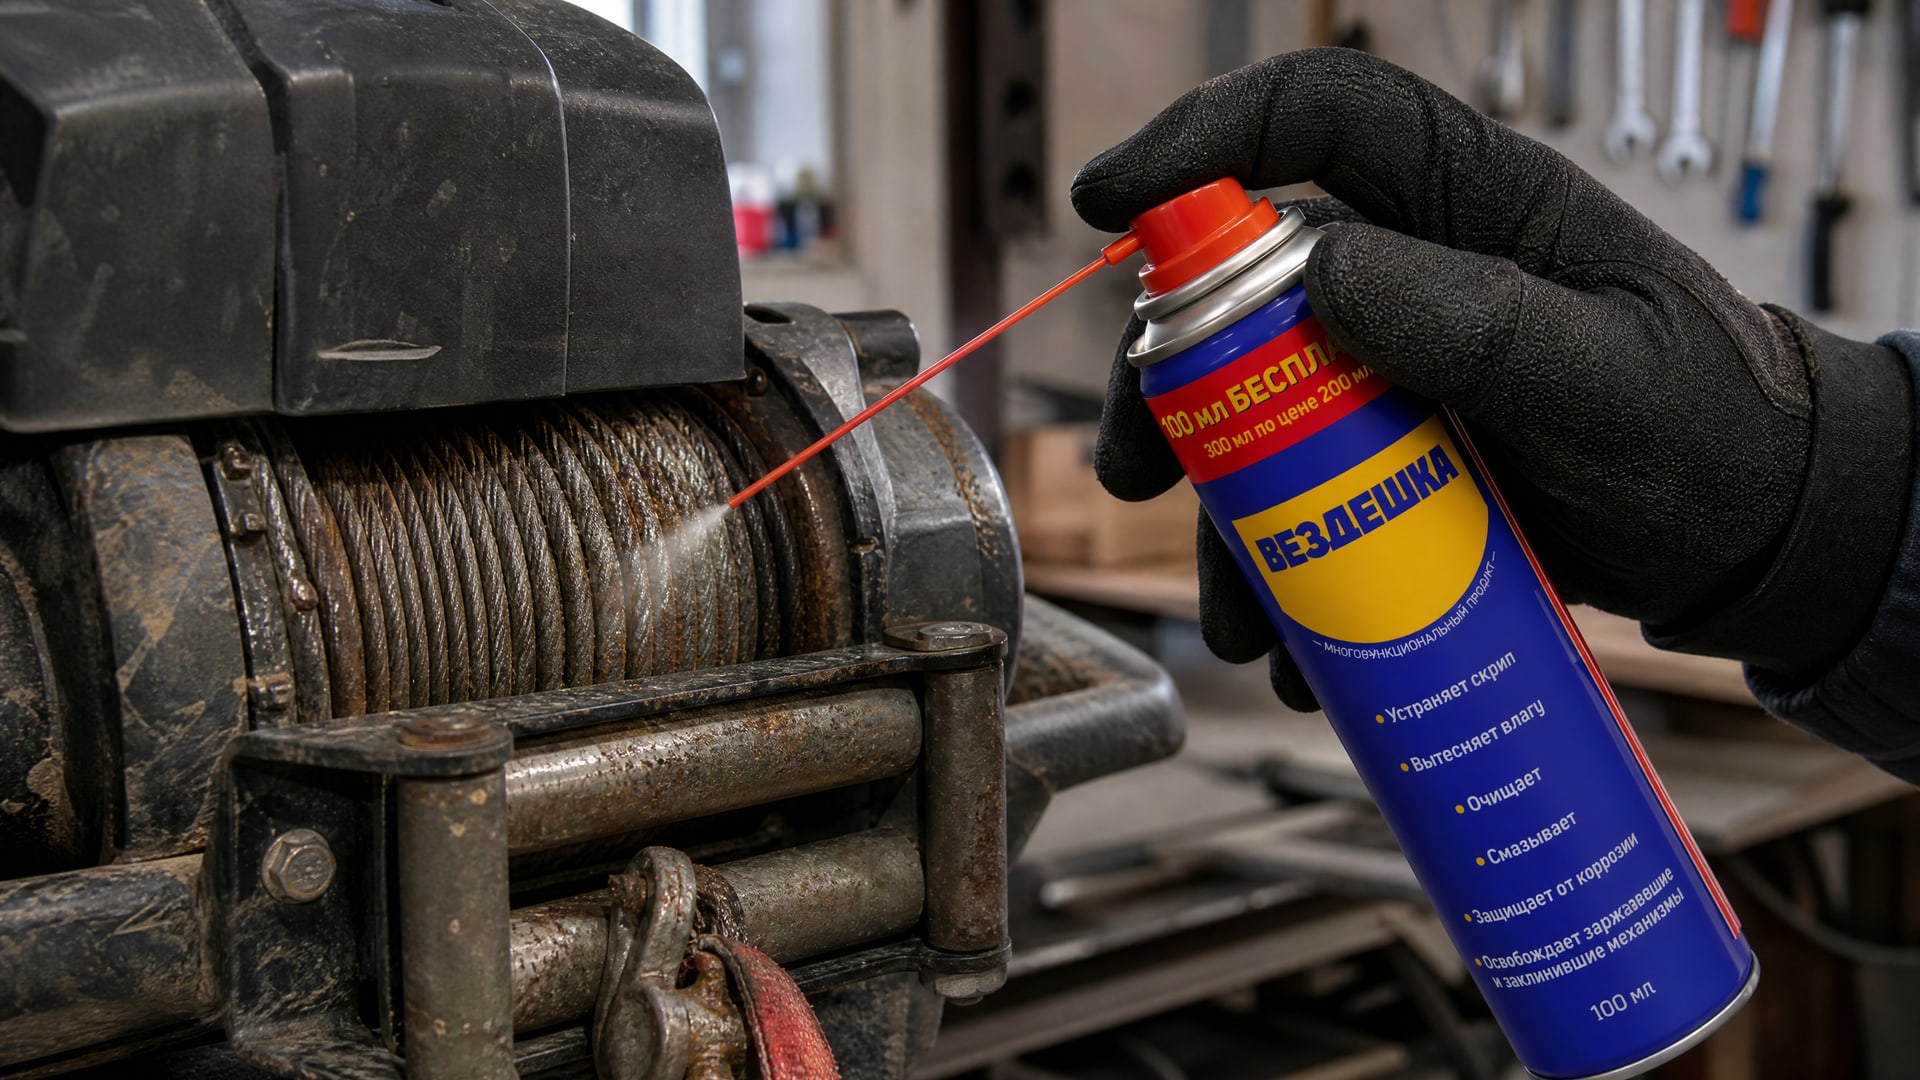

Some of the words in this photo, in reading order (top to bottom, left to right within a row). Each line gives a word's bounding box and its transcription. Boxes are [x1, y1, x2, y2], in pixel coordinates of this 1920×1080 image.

[1162, 410, 1194, 439] 100
[1194, 400, 1230, 430] мл
[1204, 436, 1232, 459] 300
[1231, 430, 1254, 447] мл
[1254, 418, 1276, 438] по
[1276, 396, 1319, 426] цене
[1317, 373, 1351, 403] 200
[1255, 444, 1459, 573] ВЕЗДЕШКА
[1385, 679, 1469, 723] Устраняет
[1470, 651, 1517, 687] скрип
[1409, 726, 1499, 772] Вытесняет
[1499, 699, 1547, 735] влагу
[1466, 767, 1542, 812] Очищает
[1486, 811, 1577, 864] Смазывает
[1471, 888, 1554, 924] Защищает
[1556, 878, 1575, 897] от
[1575, 832, 1639, 886] коррозии
[1481, 931, 1581, 970] Освобождает
[1492, 976, 1503, 989] и
[1503, 945, 1606, 990] заклинившие
[1606, 887, 1685, 954] механизмы
[1589, 993, 1628, 1022] 100
[1629, 981, 1657, 1005] мл
